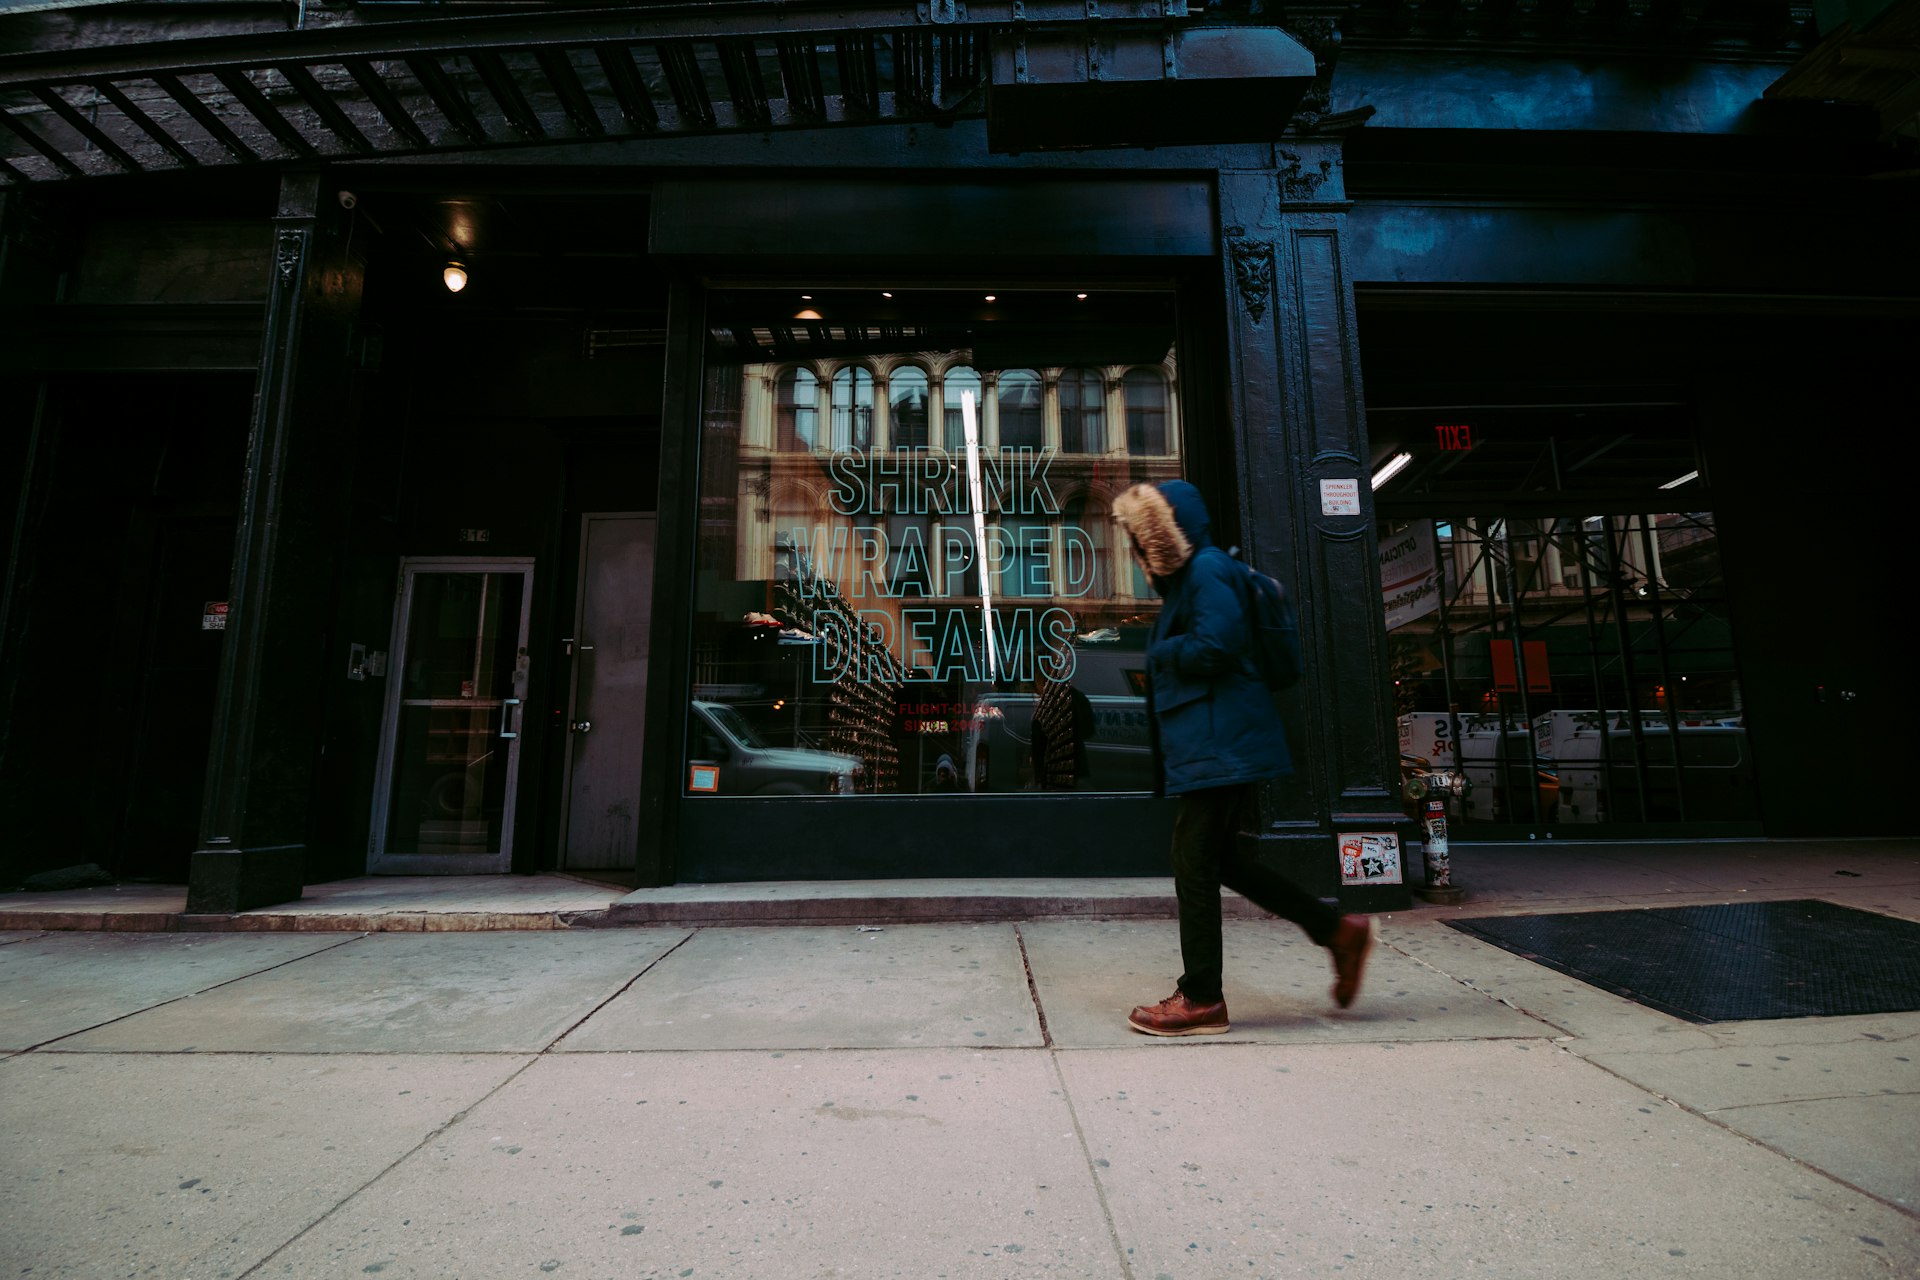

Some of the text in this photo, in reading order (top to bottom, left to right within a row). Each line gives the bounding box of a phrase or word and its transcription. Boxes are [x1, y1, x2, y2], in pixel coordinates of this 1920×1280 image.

[828, 445, 1060, 515] SHRINK
[793, 526, 1097, 598] WRAPPED
[812, 607, 1077, 684] DREAMS
[899, 703, 950, 715] FLIGHT
[903, 719, 948, 732] SINCE
